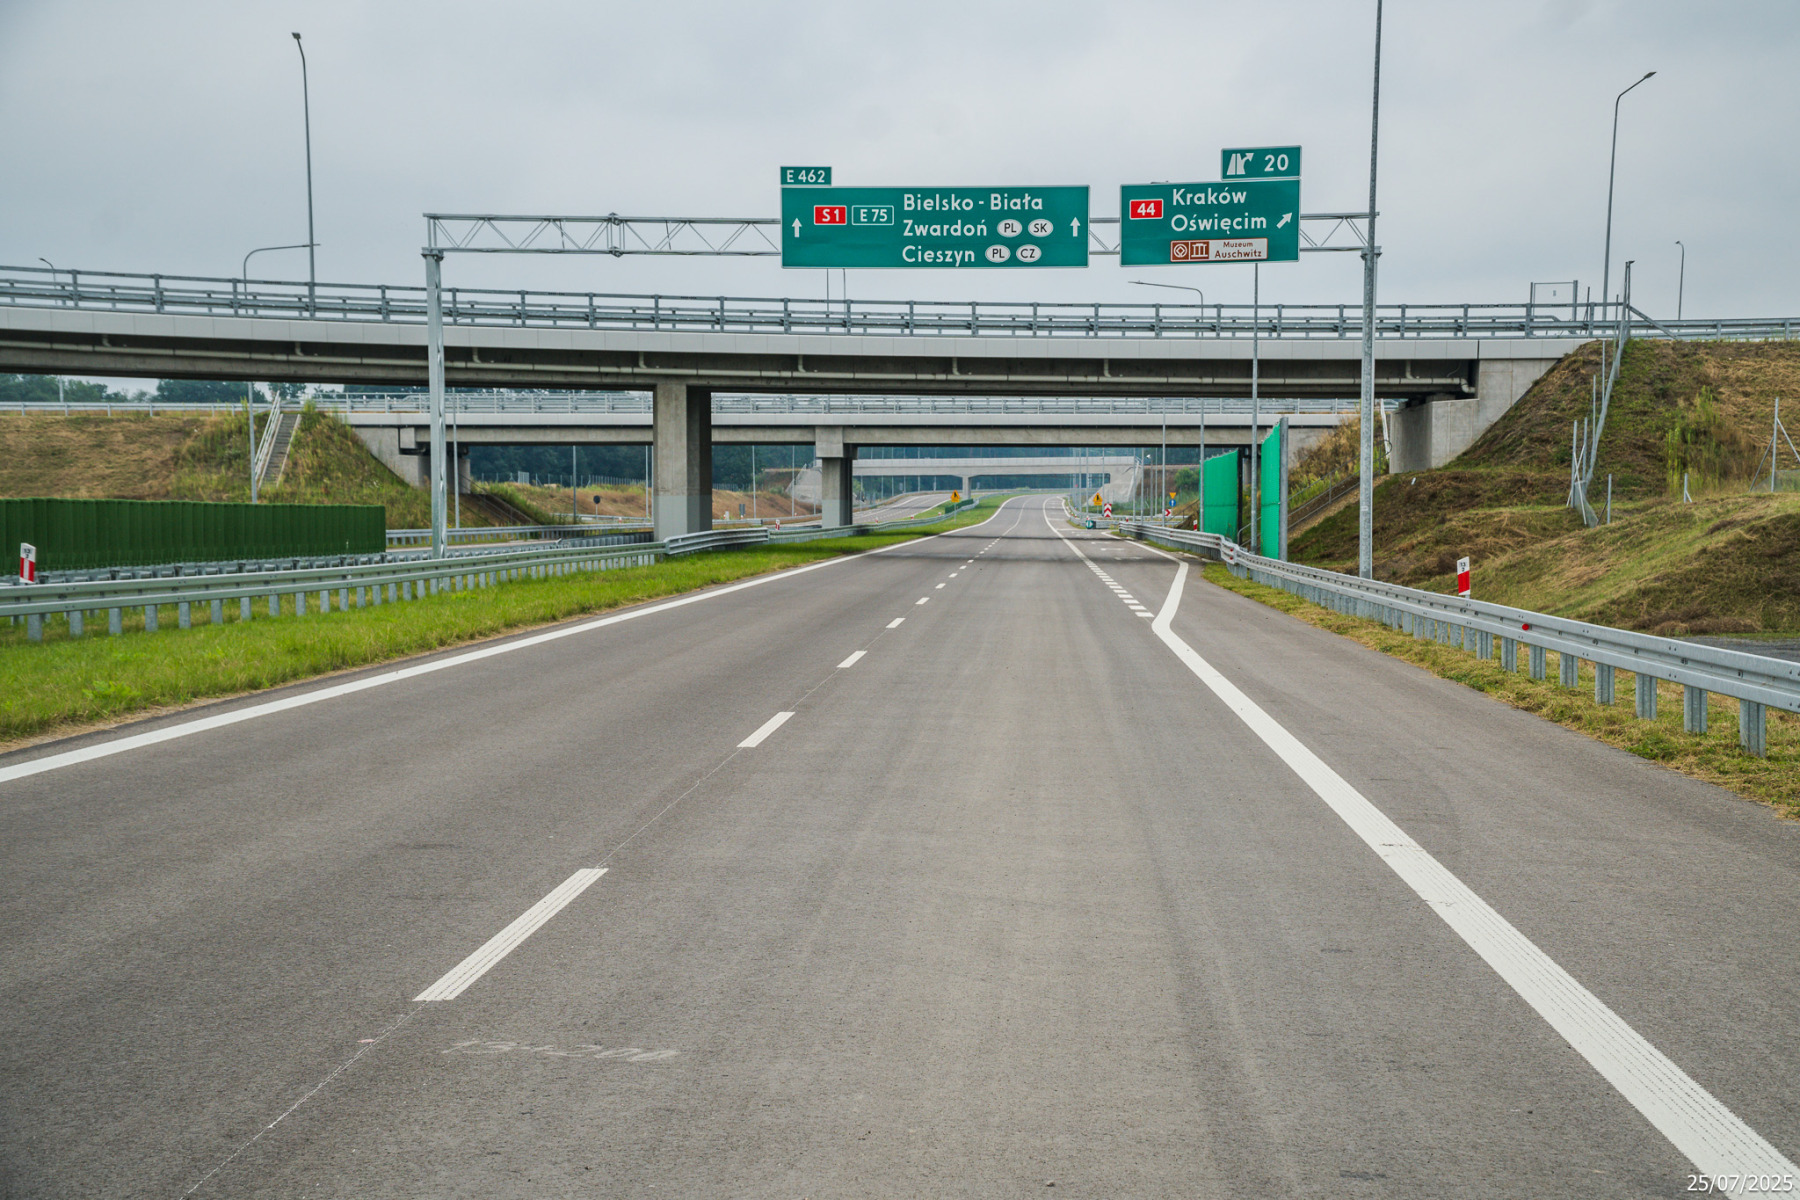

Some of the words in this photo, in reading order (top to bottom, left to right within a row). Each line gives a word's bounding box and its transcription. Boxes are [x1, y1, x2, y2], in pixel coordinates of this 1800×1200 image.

[1264, 154, 1289, 171] 20
[786, 170, 794, 182] E
[798, 169, 826, 182] 462
[990, 193, 1043, 210] Biała
[1172, 187, 1247, 206] Kraków
[860, 209, 868, 222] E
[871, 209, 888, 222] 75
[1137, 203, 1156, 216] 44
[903, 219, 987, 237] Zwardoń
[1003, 223, 1017, 234] PL
[1033, 222, 1048, 234] SK
[1171, 213, 1267, 234] Oświęcim
[902, 246, 975, 266] Cieszyn
[992, 248, 1005, 259] PL
[1021, 248, 1036, 259] CZ
[1215, 250, 1262, 258] Auschwitz
